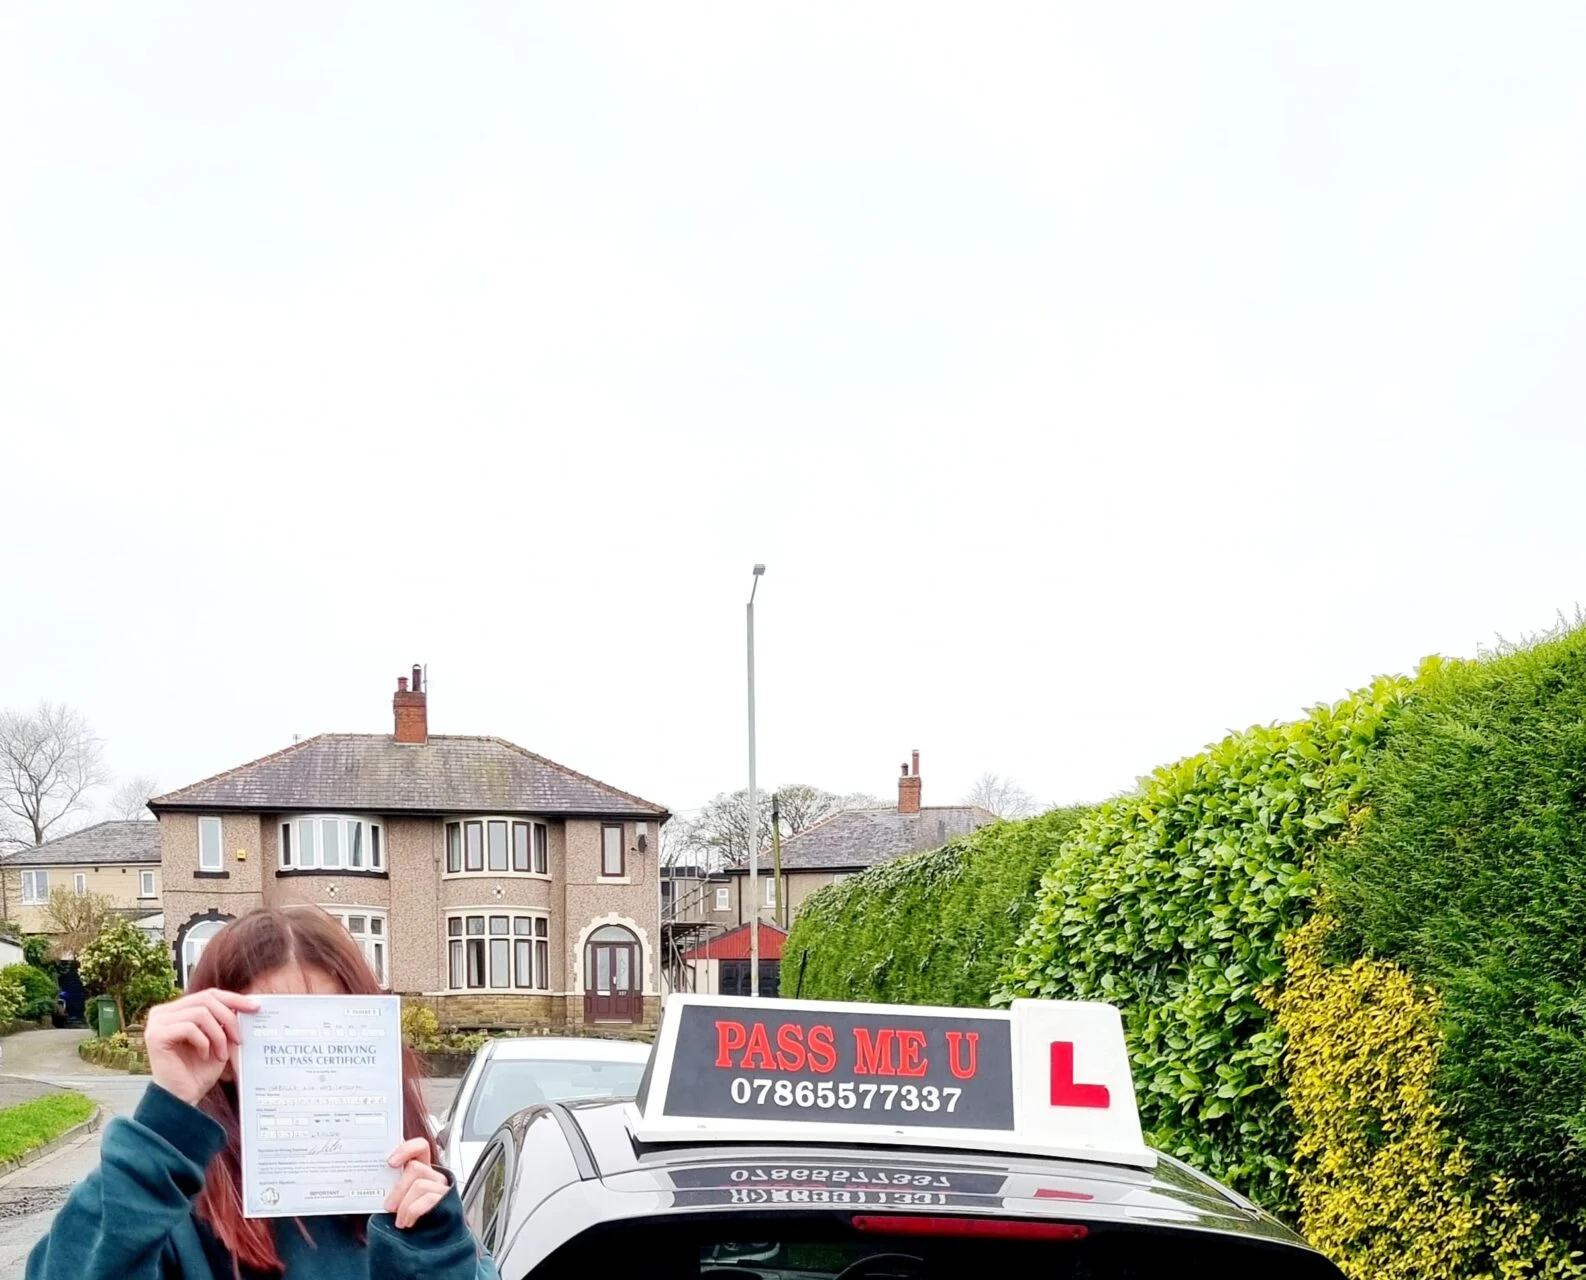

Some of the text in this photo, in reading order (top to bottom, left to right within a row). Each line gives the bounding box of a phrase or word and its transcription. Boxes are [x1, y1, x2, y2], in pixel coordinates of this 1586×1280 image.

[263, 1045, 377, 1054] PRACTICAL DRIVING
[264, 1056, 377, 1065] TEST PASS CERTIFICATE
[715, 1020, 980, 1079] PASS ME U
[1050, 1041, 1110, 1109] L
[731, 1077, 963, 1113] 07865577337
